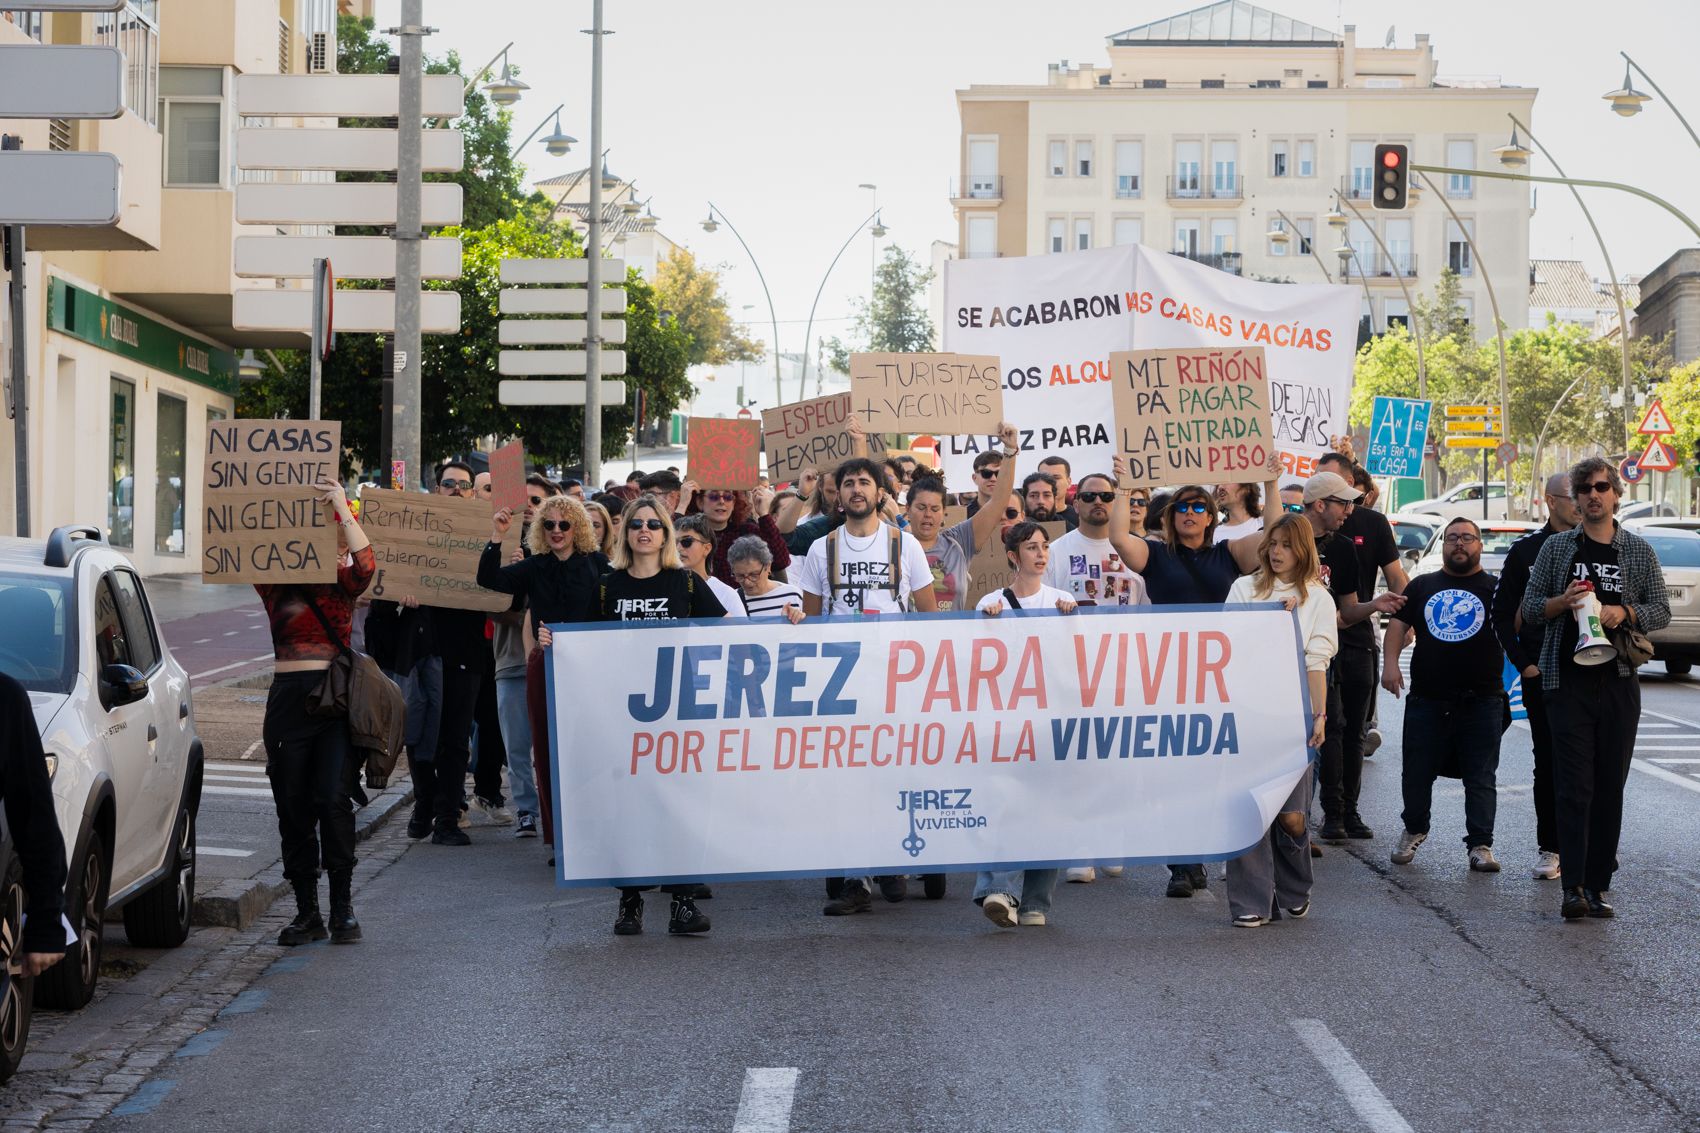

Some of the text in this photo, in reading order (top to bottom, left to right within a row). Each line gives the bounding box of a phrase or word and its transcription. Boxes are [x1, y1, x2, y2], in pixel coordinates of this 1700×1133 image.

[958, 307, 982, 328] SE
[989, 293, 1121, 328] ACABARON
[1160, 296, 1232, 337] CASAS
[1240, 321, 1332, 352] VACÍAS
[1002, 360, 1111, 391] OS ALQU
[1127, 350, 1262, 389] MI RIÑÓN
[1137, 385, 1261, 415] PA PAGAR
[1272, 381, 1331, 418] DEJAN
[209, 428, 332, 454] NI CASAS
[951, 423, 1110, 454] LA PZ PARA
[1124, 417, 1262, 453] LA ENTRADA
[1271, 412, 1328, 446] ASAS
[1130, 444, 1266, 480] DE UN PISO
[1371, 445, 1387, 456] ESA
[1391, 446, 1405, 457] ERA
[1408, 448, 1418, 459] MI
[1378, 457, 1408, 475] CASA
[208, 461, 331, 488] SIN GENTE
[207, 498, 325, 534] NI GENTE
[361, 500, 454, 534] Rentistas
[205, 541, 321, 574] SIN CASA
[375, 547, 449, 569] obiernos
[427, 534, 486, 554] culpable
[840, 562, 889, 576] JEREZ
[614, 597, 669, 613] JEREZ
[628, 630, 1232, 722] JEREZ PARA VIVIR
[630, 712, 1239, 775] POR EL DERECHO A LA VIVIENDA
[897, 788, 972, 811] JEREZ
[915, 816, 987, 830] VIVIENDA
